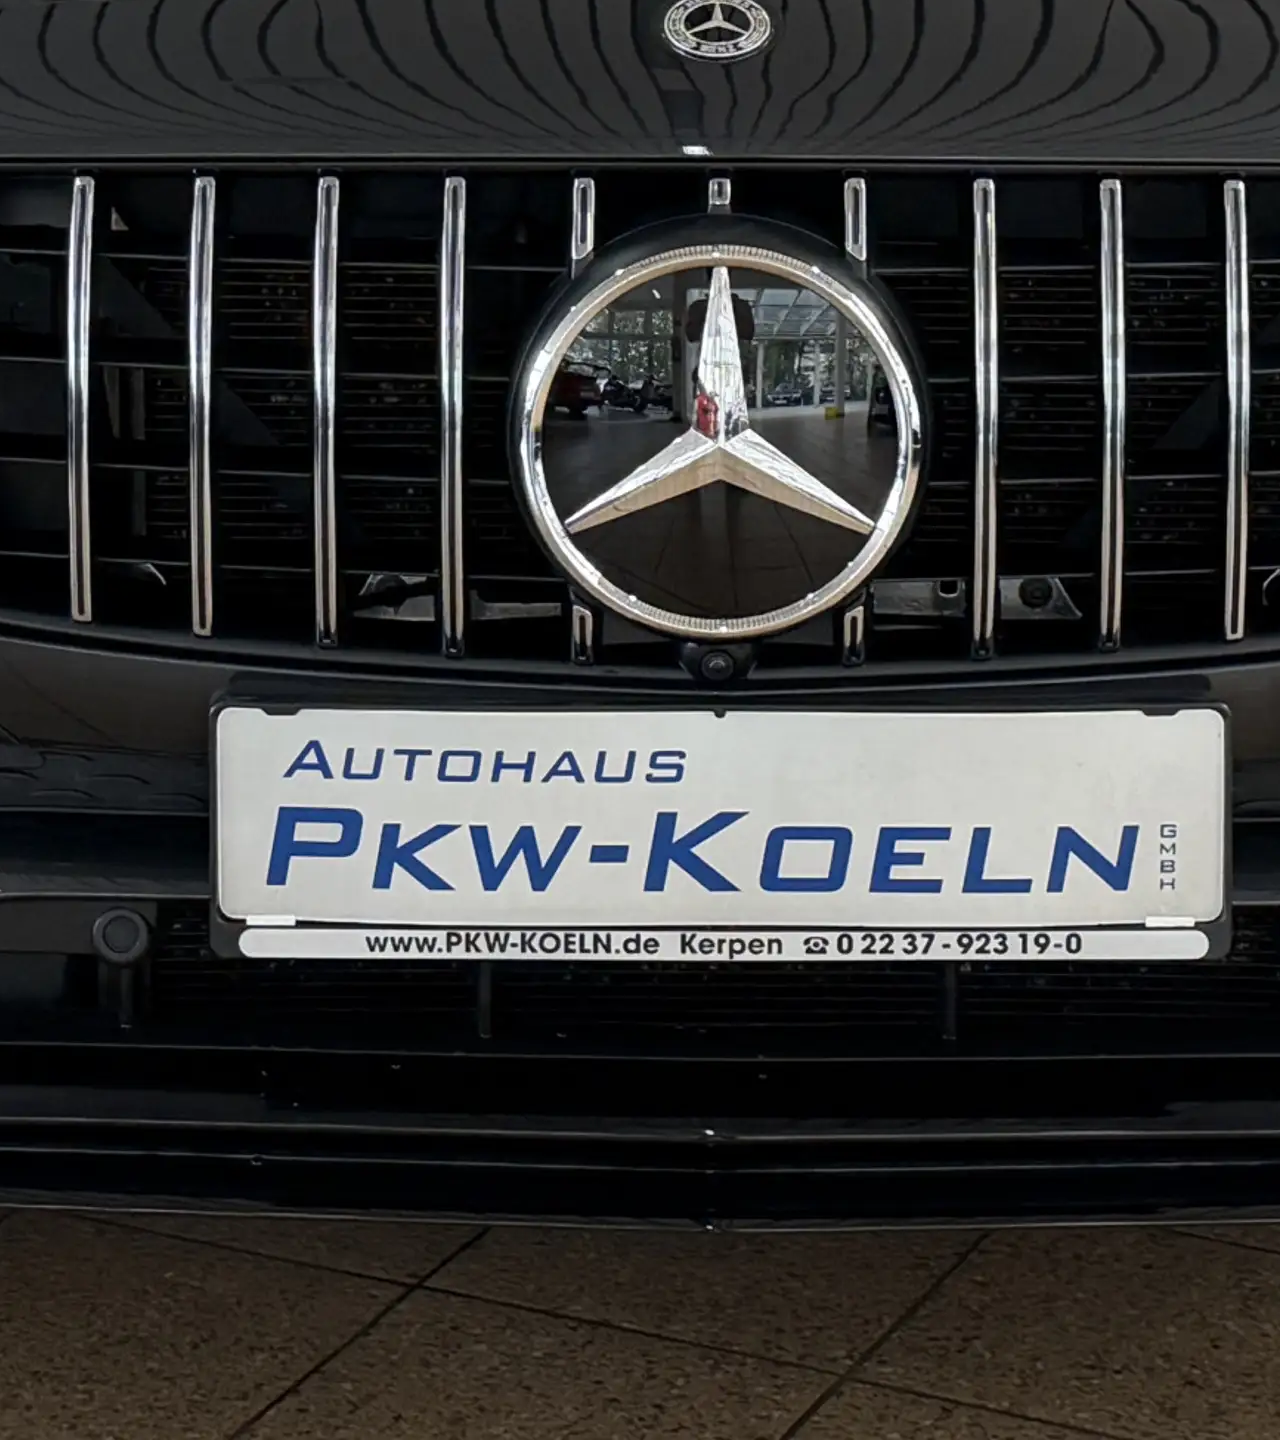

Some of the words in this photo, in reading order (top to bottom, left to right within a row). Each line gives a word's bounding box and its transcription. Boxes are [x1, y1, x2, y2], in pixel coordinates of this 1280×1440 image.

[284, 740, 686, 783] AUTOHAUS
[266, 806, 1139, 893] PKW-KOELN
[1160, 824, 1177, 890] GMBH
[366, 932, 660, 955] www.PKW-KOELN.de
[680, 933, 783, 960] Kerpen
